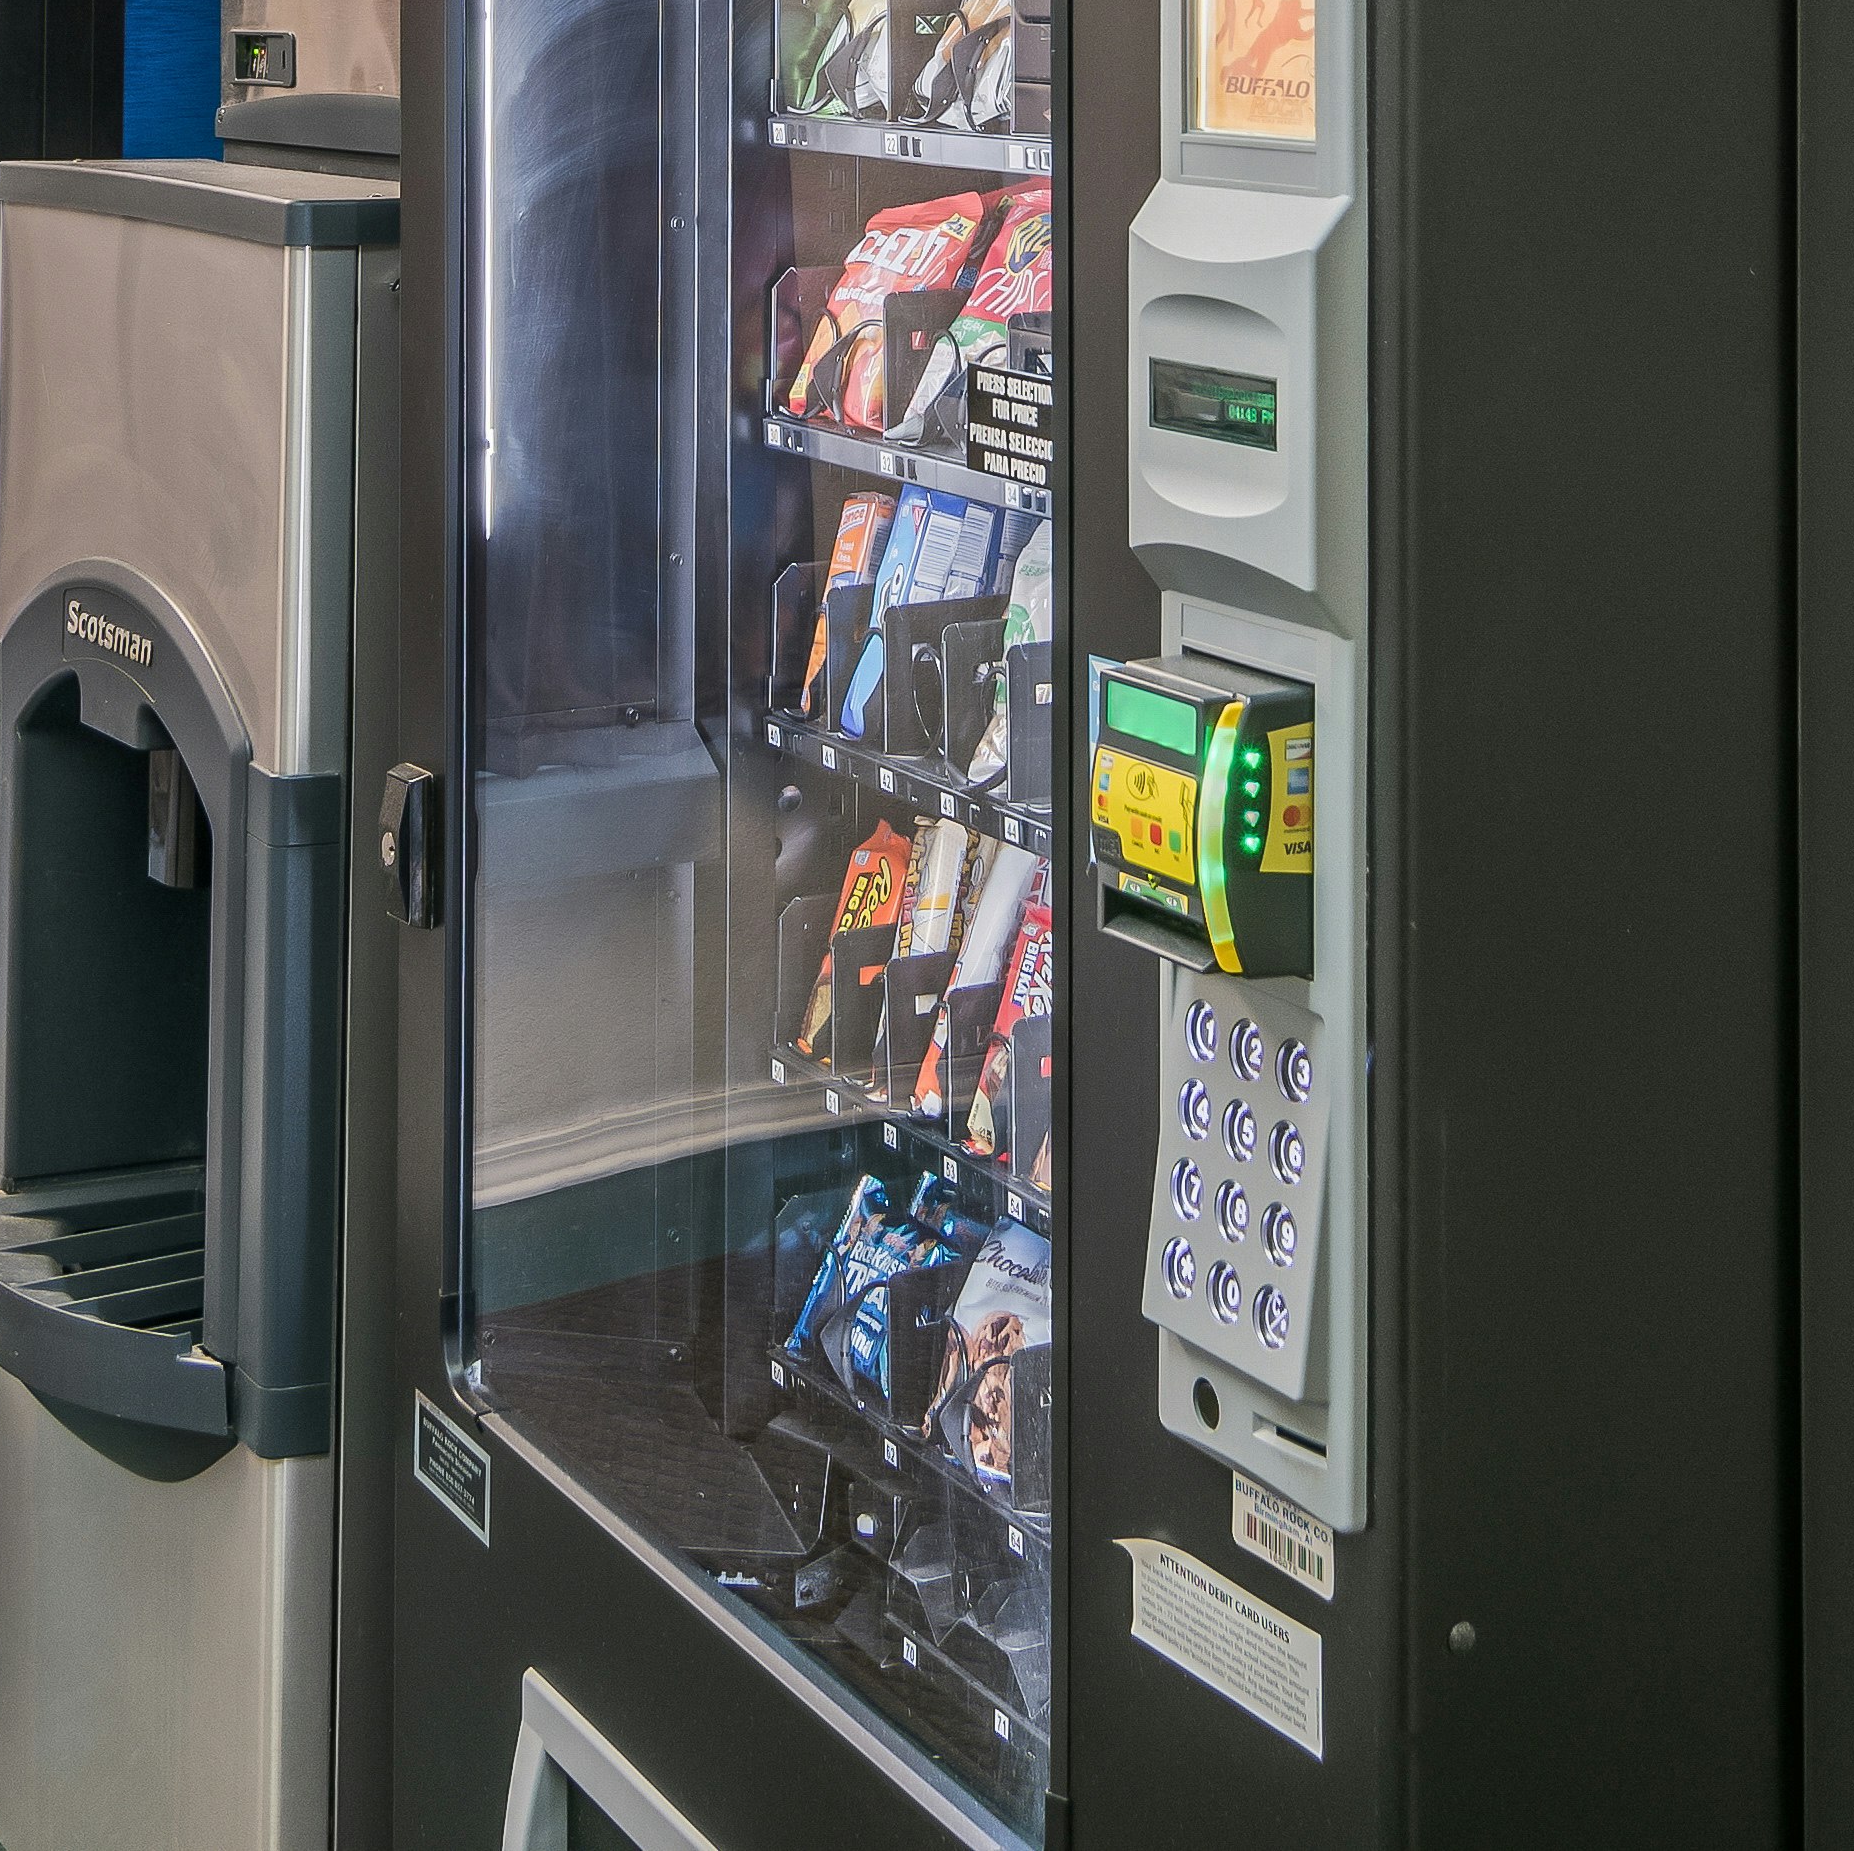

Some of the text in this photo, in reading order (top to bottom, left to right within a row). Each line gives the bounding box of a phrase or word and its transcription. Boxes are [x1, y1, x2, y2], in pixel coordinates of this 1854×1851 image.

[1225, 76, 1310, 98] BUFFALO
[886, 136, 896, 153] 22
[976, 370, 1005, 396] PRESS
[992, 398, 1038, 428] FOR PRICE
[969, 422, 1053, 462] PRENSA SELECCIO
[882, 455, 892, 472] 32
[983, 450, 1046, 487] PARA PRECIO
[67, 600, 153, 667] Scotsman
[769, 729, 1017, 842] 40 41 42 43 44
[1284, 841, 1311, 855] VISA
[848, 876, 868, 910] BIG
[1235, 1478, 1279, 1513] BUFFALO
[1282, 1508, 1310, 1533] ROCK
[1160, 1553, 1290, 1644] ATTENTION DEBIT CARD USERS
[905, 1642, 1008, 1734] 70 71
